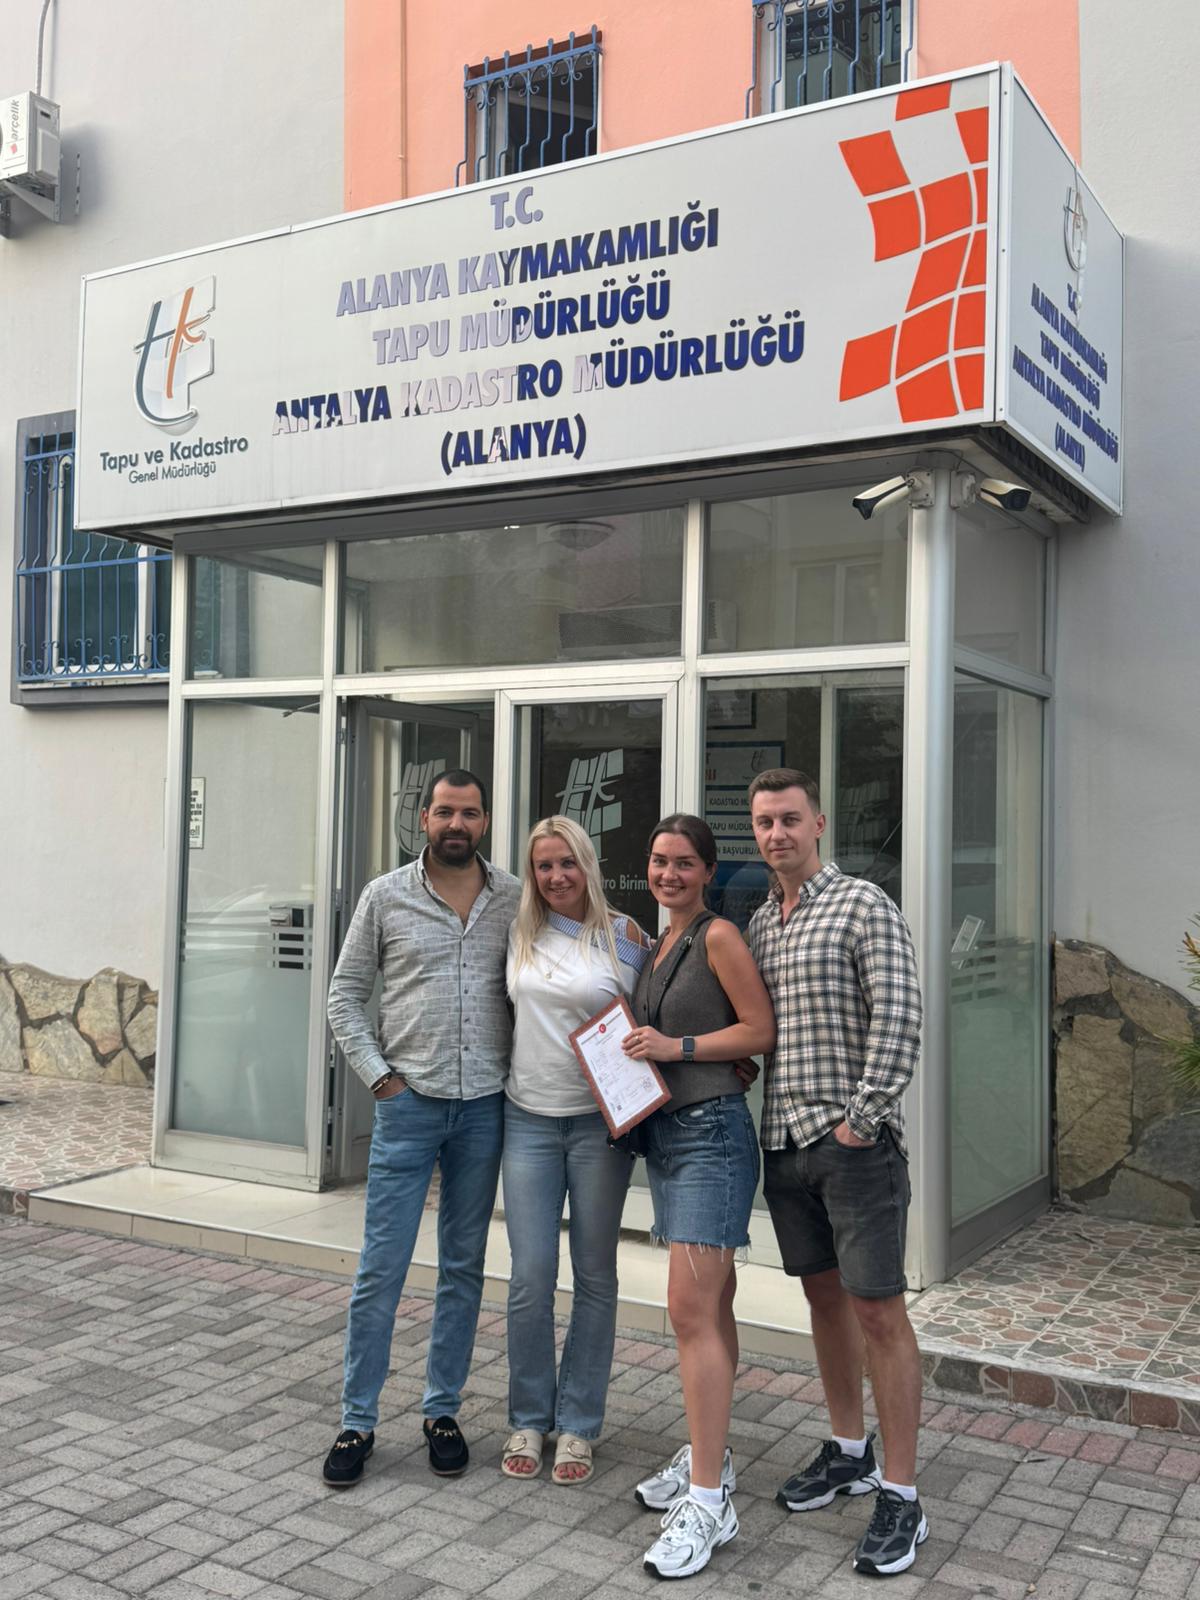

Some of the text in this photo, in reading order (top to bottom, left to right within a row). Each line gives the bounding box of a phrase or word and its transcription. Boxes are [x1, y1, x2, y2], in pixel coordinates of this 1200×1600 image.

[10, 100, 20, 142] arçelik
[490, 185, 544, 231] T.C.
[336, 199, 719, 318] ALANYA KAYMAKAMLIĞI
[373, 268, 671, 366] TAPU MÜDÜRLÜĞÜ
[272, 309, 805, 436] ANTALYA KADASTRO MÜDÜRLÜĞÜ
[100, 435, 249, 474] Tapu ve Kadastro
[441, 413, 587, 476] (ALANYA)
[129, 460, 217, 484] Genel Müdürlüğü
[709, 822, 727, 831] TAPU
[619, 874, 650, 890] Birim
